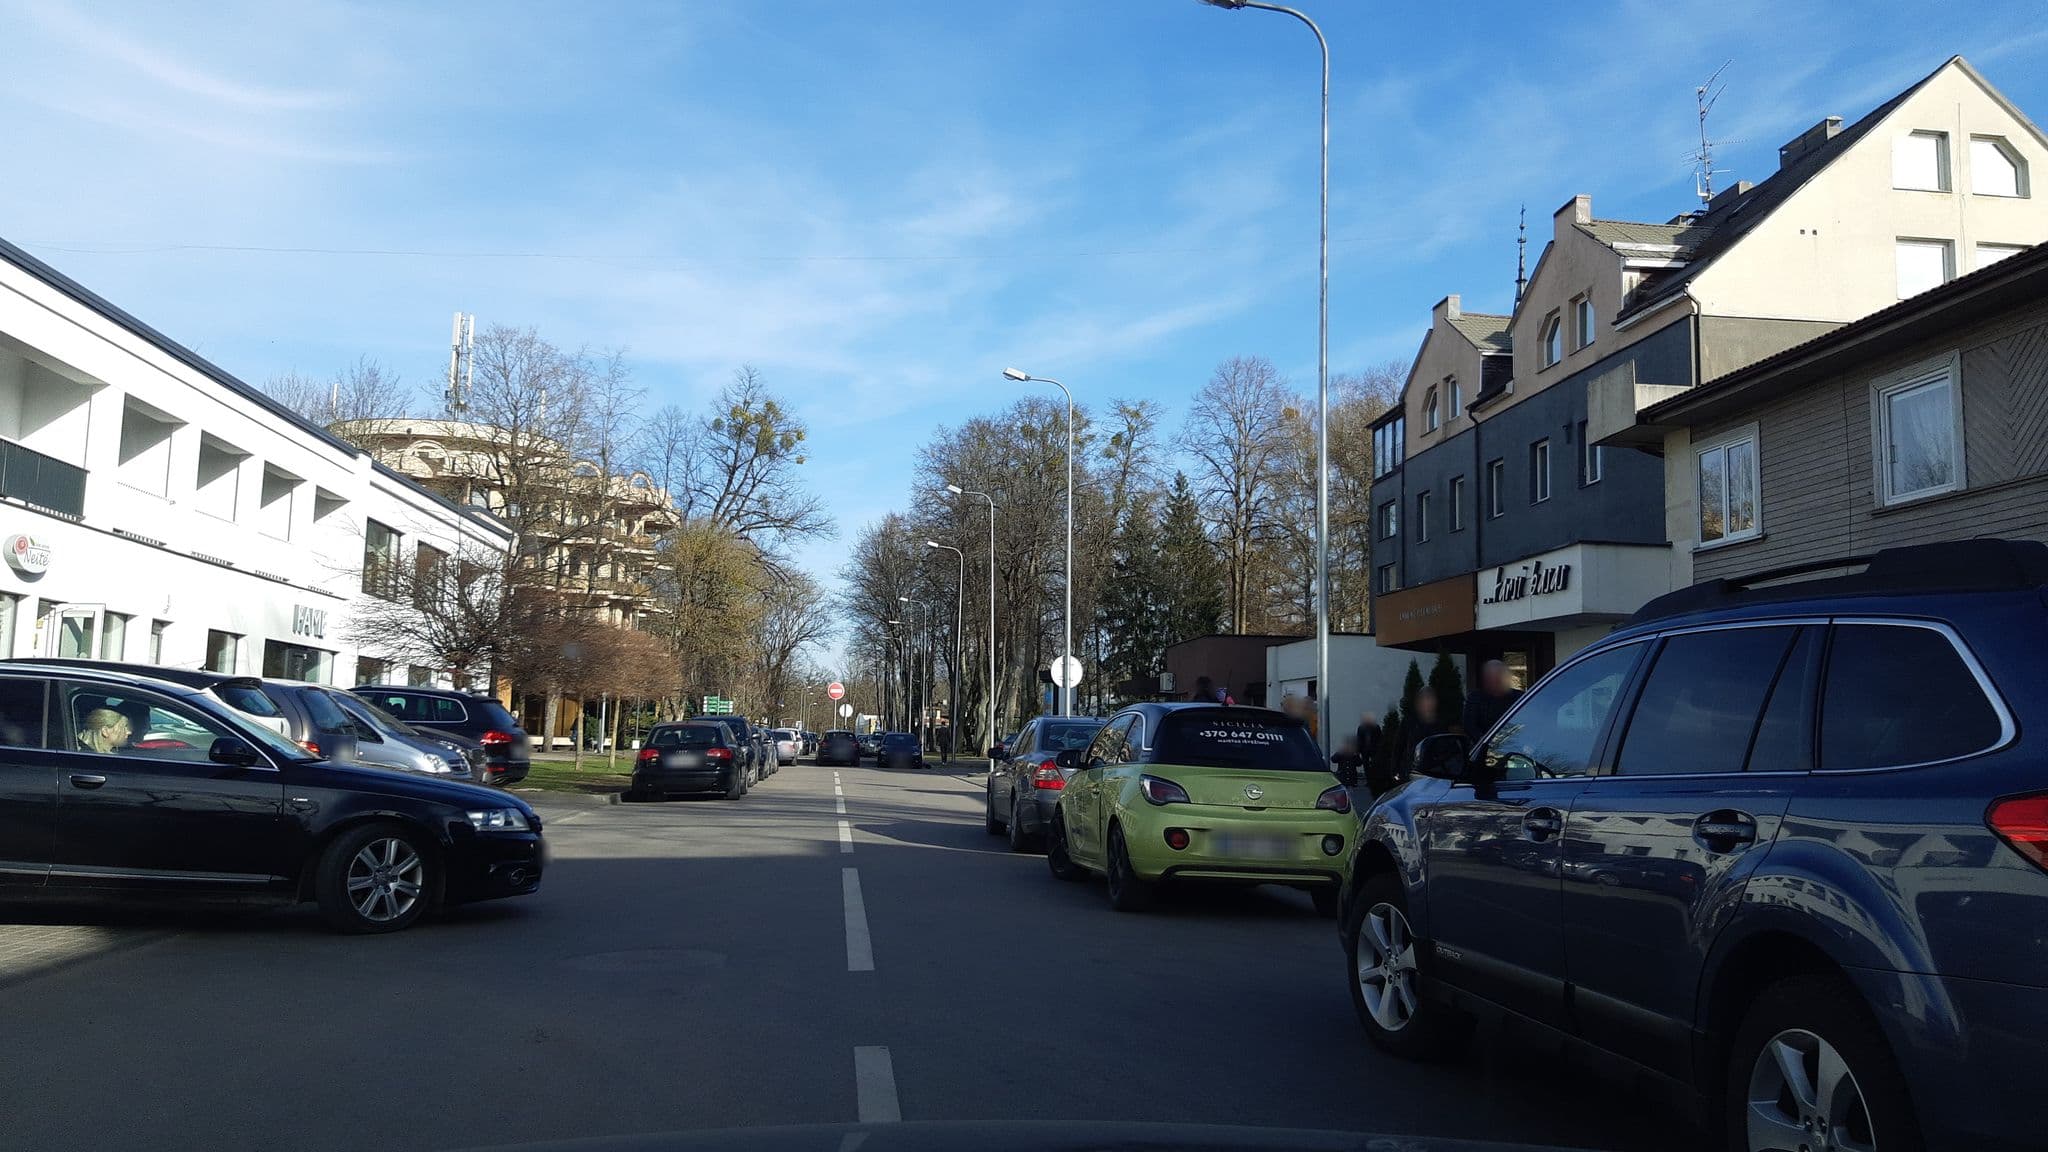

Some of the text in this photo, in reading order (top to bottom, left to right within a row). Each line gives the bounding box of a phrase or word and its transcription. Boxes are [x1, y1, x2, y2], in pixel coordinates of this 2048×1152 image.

[1212, 720, 1264, 729] SICILIA
[1200, 730, 1284, 742] +370 647 01111
